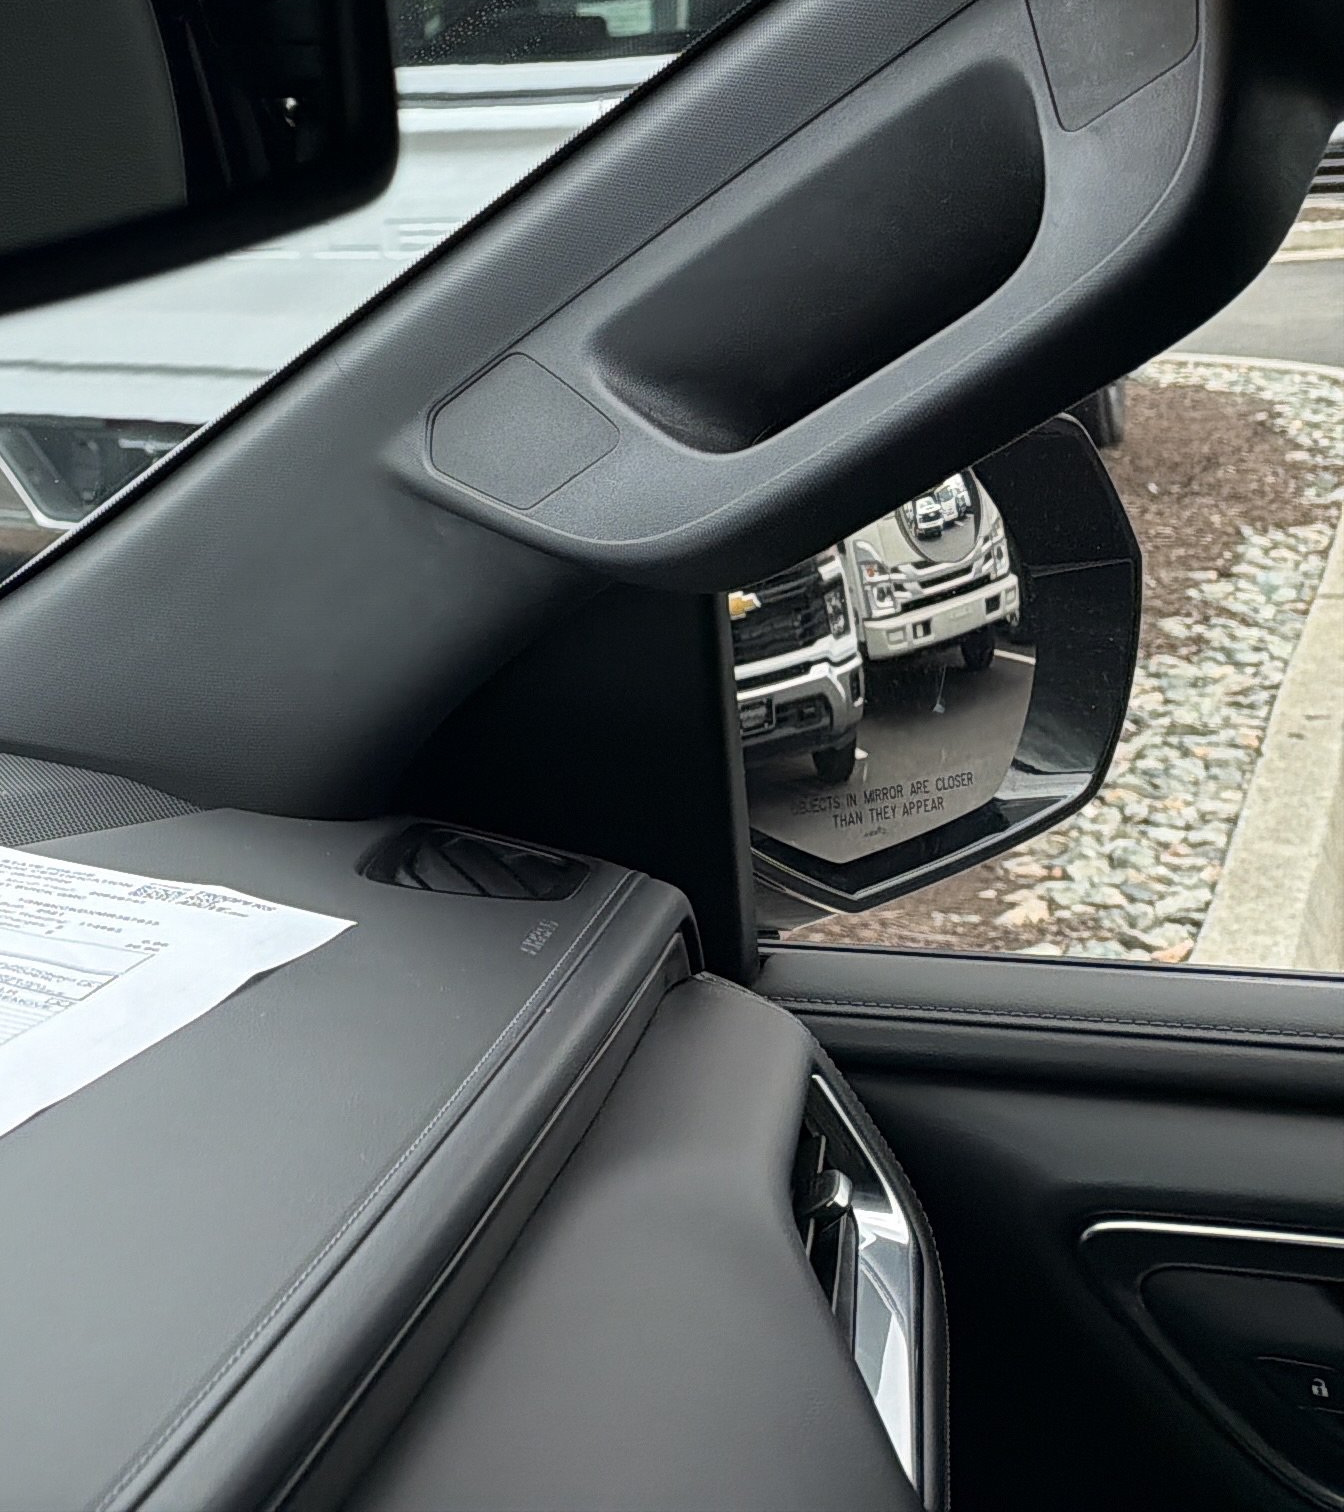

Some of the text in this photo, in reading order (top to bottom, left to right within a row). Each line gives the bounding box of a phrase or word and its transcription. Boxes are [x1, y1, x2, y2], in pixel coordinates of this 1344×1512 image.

[846, 792, 857, 807] IN
[863, 783, 904, 804] MIRROR
[910, 779, 930, 795] ARE
[935, 771, 973, 792] CLOSER
[832, 796, 945, 829] THAN THEY APPEAR
